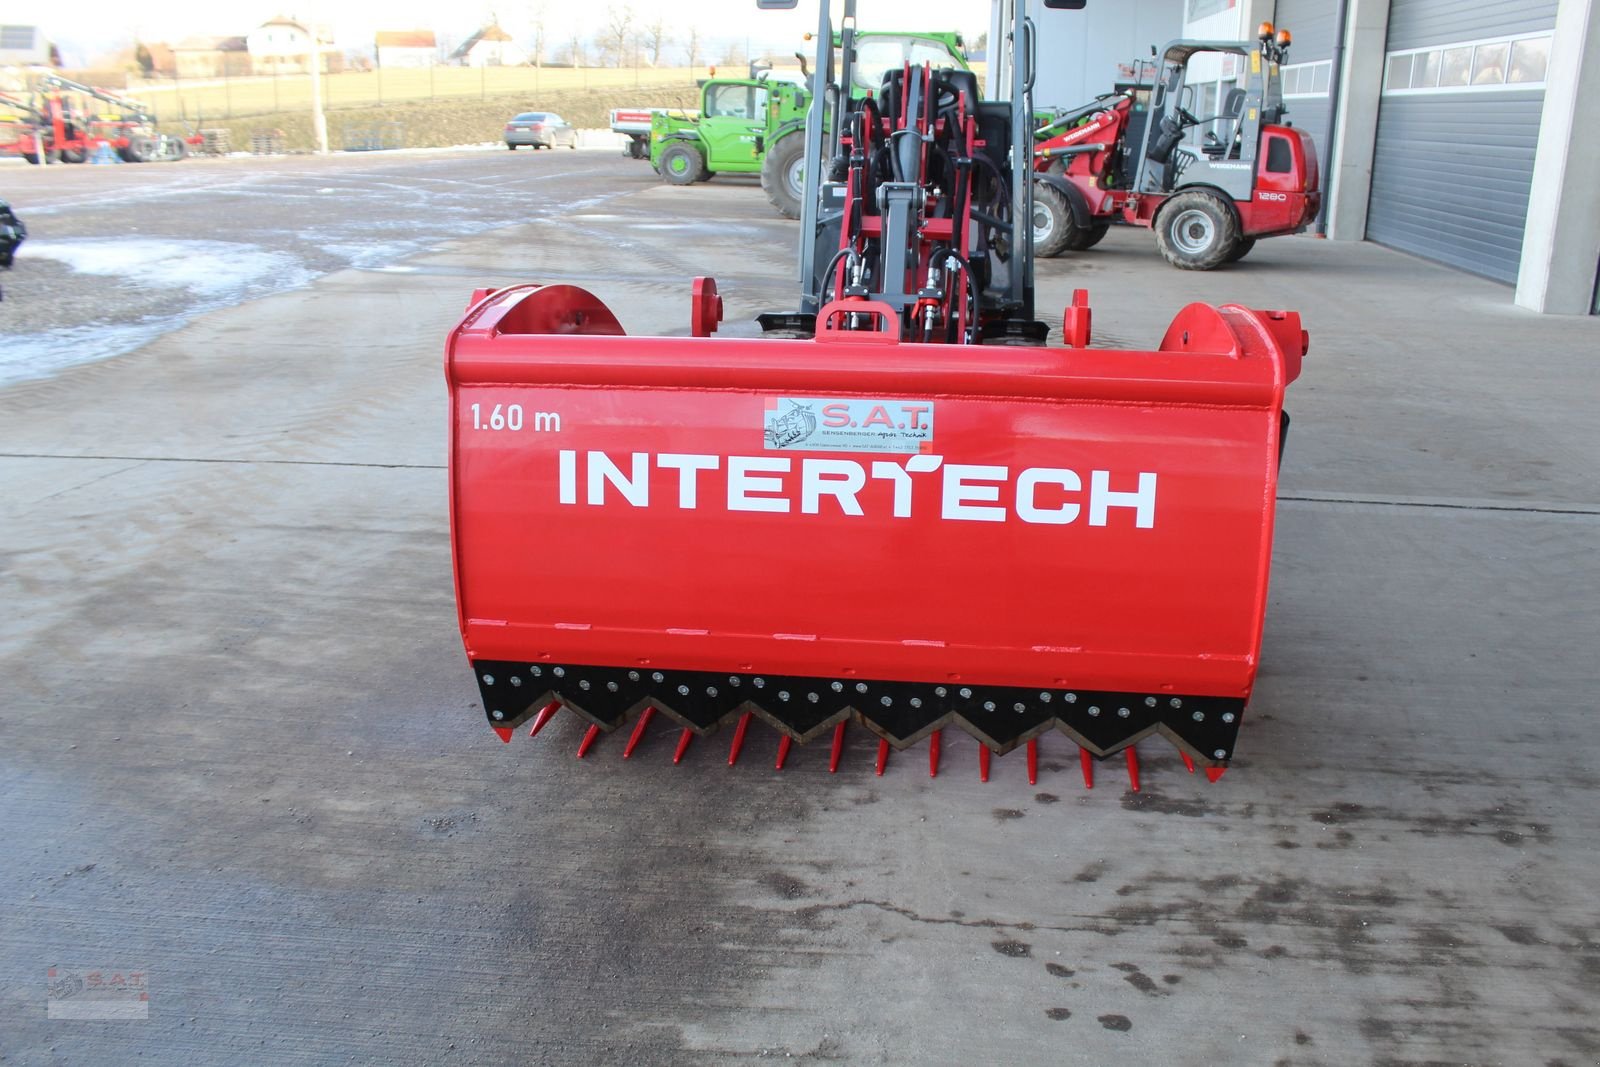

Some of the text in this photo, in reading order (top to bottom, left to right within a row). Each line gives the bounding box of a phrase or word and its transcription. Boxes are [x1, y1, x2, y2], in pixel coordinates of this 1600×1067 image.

[1258, 192, 1287, 201] 1280
[471, 403, 561, 432] 1.60 m
[823, 404, 928, 430] S.A.T.
[559, 450, 1157, 529] INTERTECH
